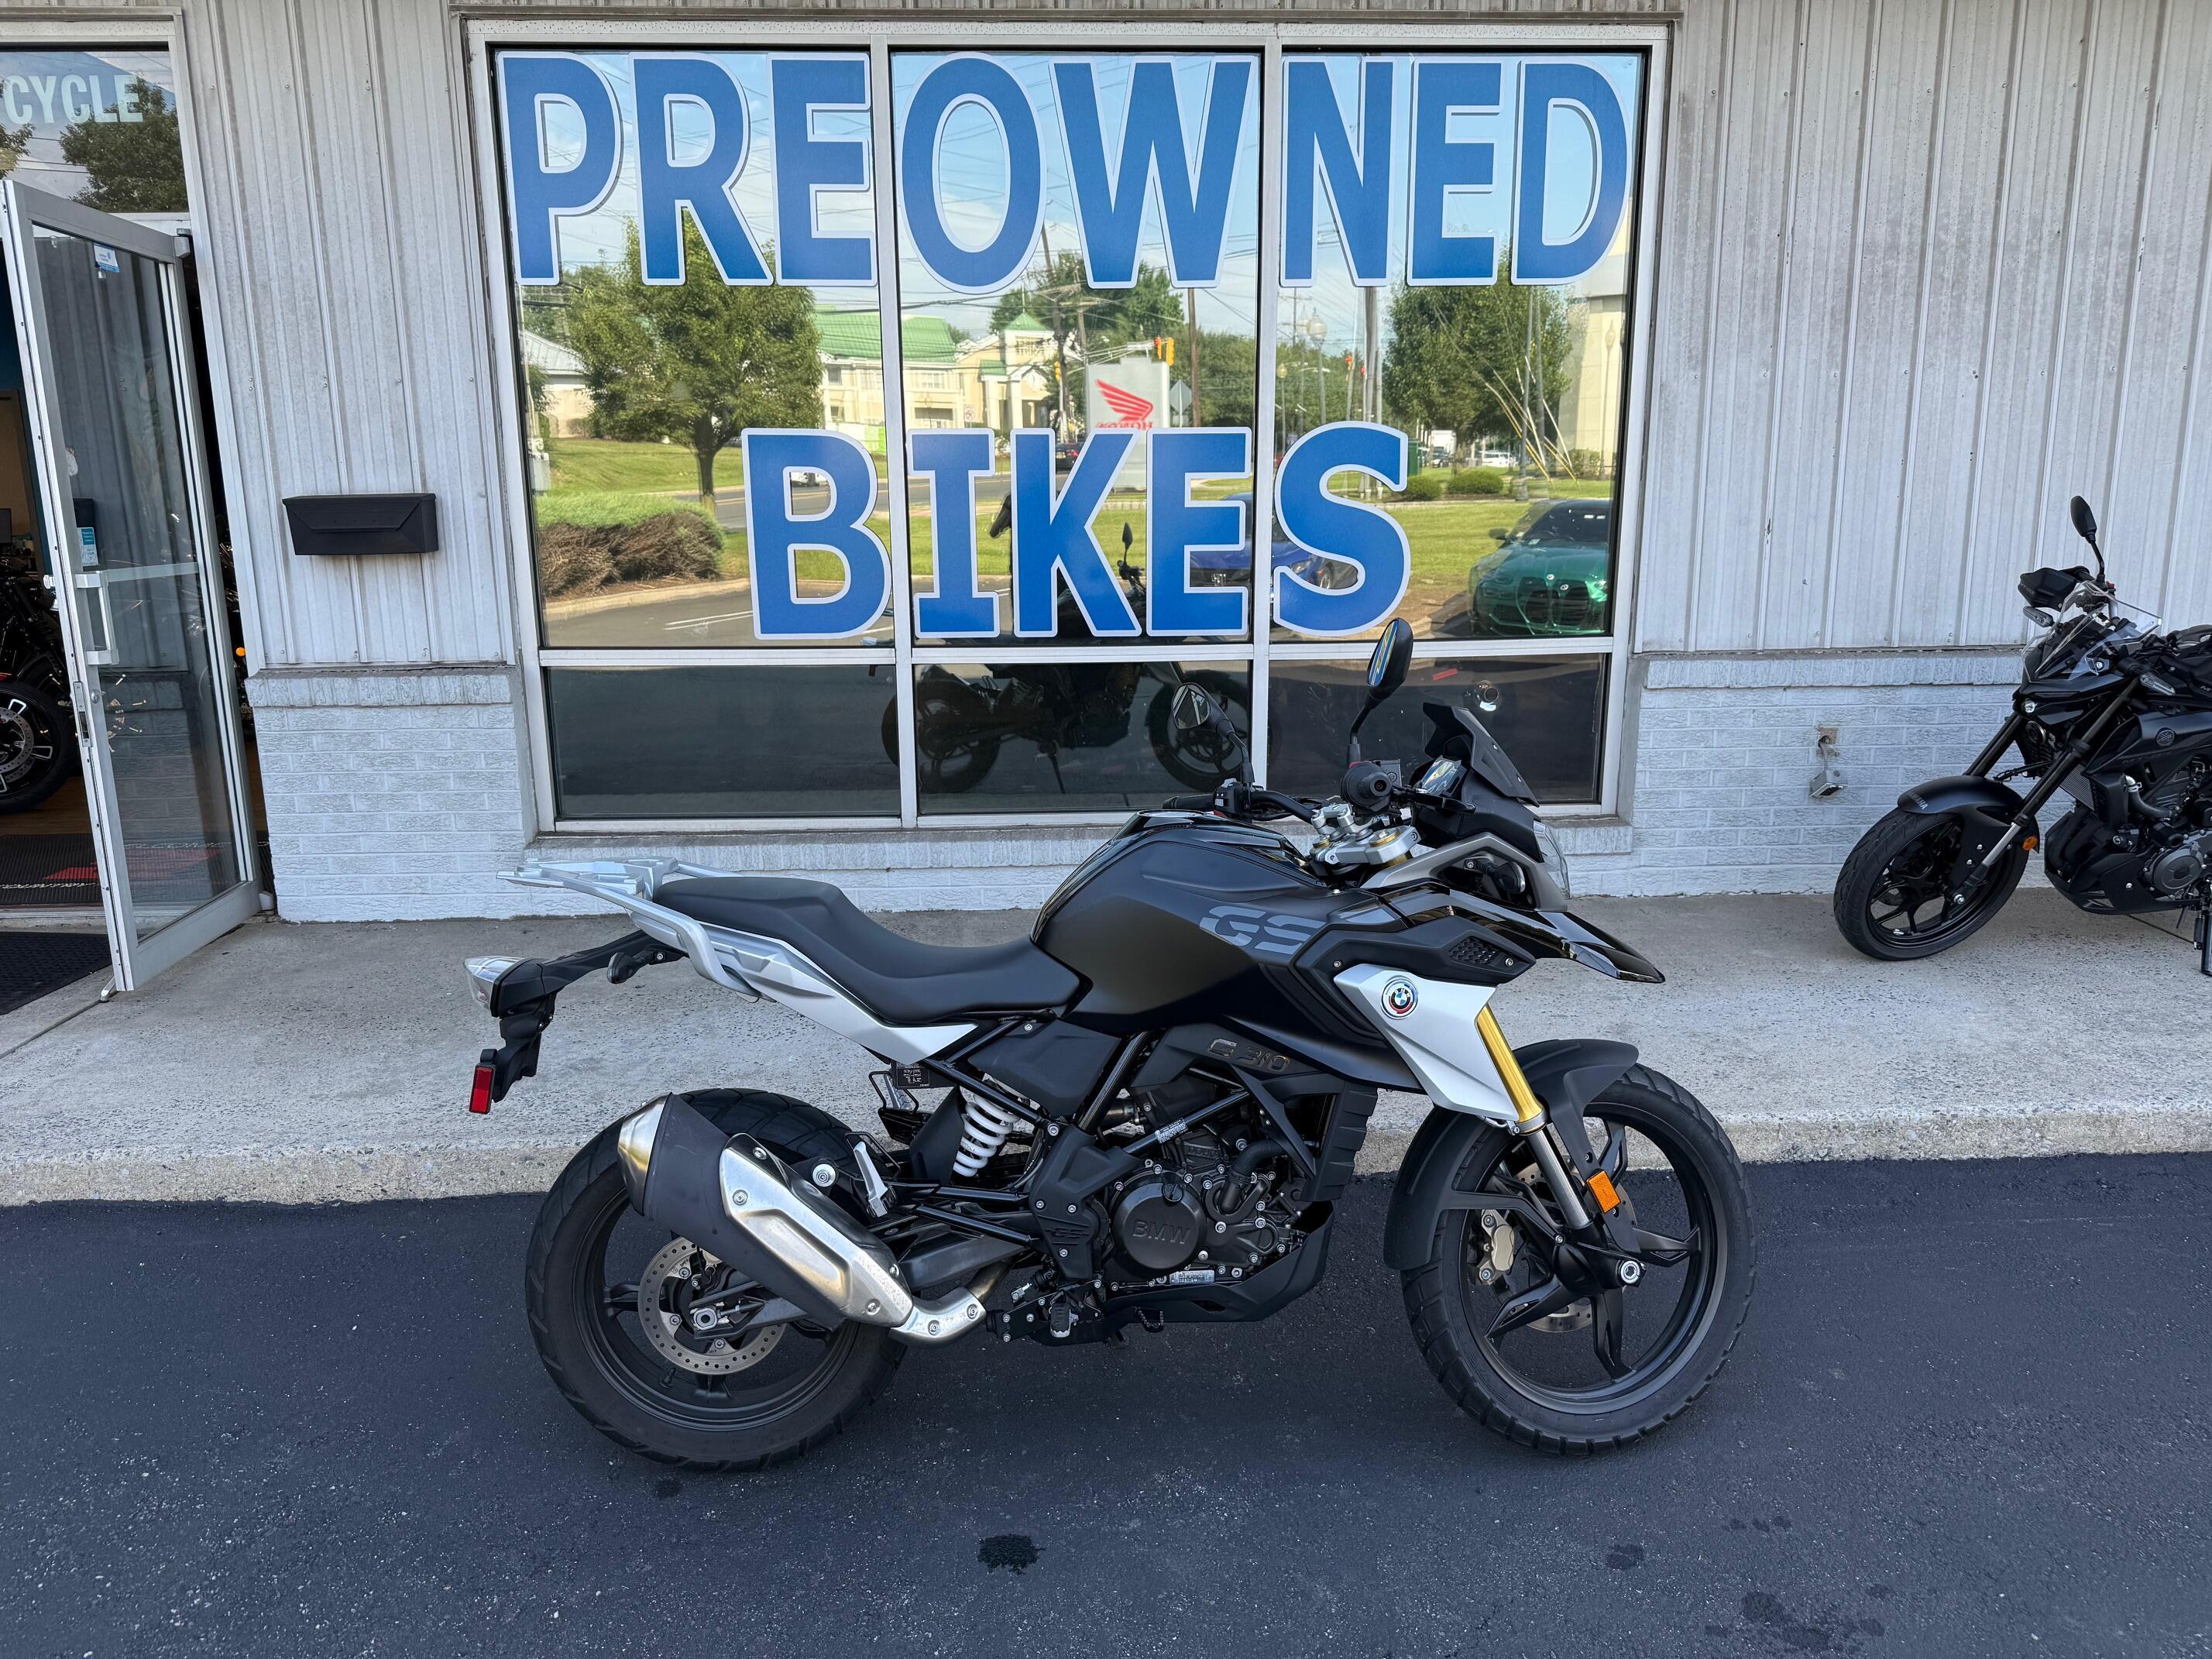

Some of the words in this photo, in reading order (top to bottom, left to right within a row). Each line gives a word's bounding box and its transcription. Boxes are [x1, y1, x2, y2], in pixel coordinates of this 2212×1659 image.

[4, 74, 143, 124] CYCLE
[498, 51, 1632, 294] PREOWNED
[741, 421, 1411, 641] BIKES
[1200, 905, 1326, 955] GS
[1132, 1220, 1191, 1245] BMW
